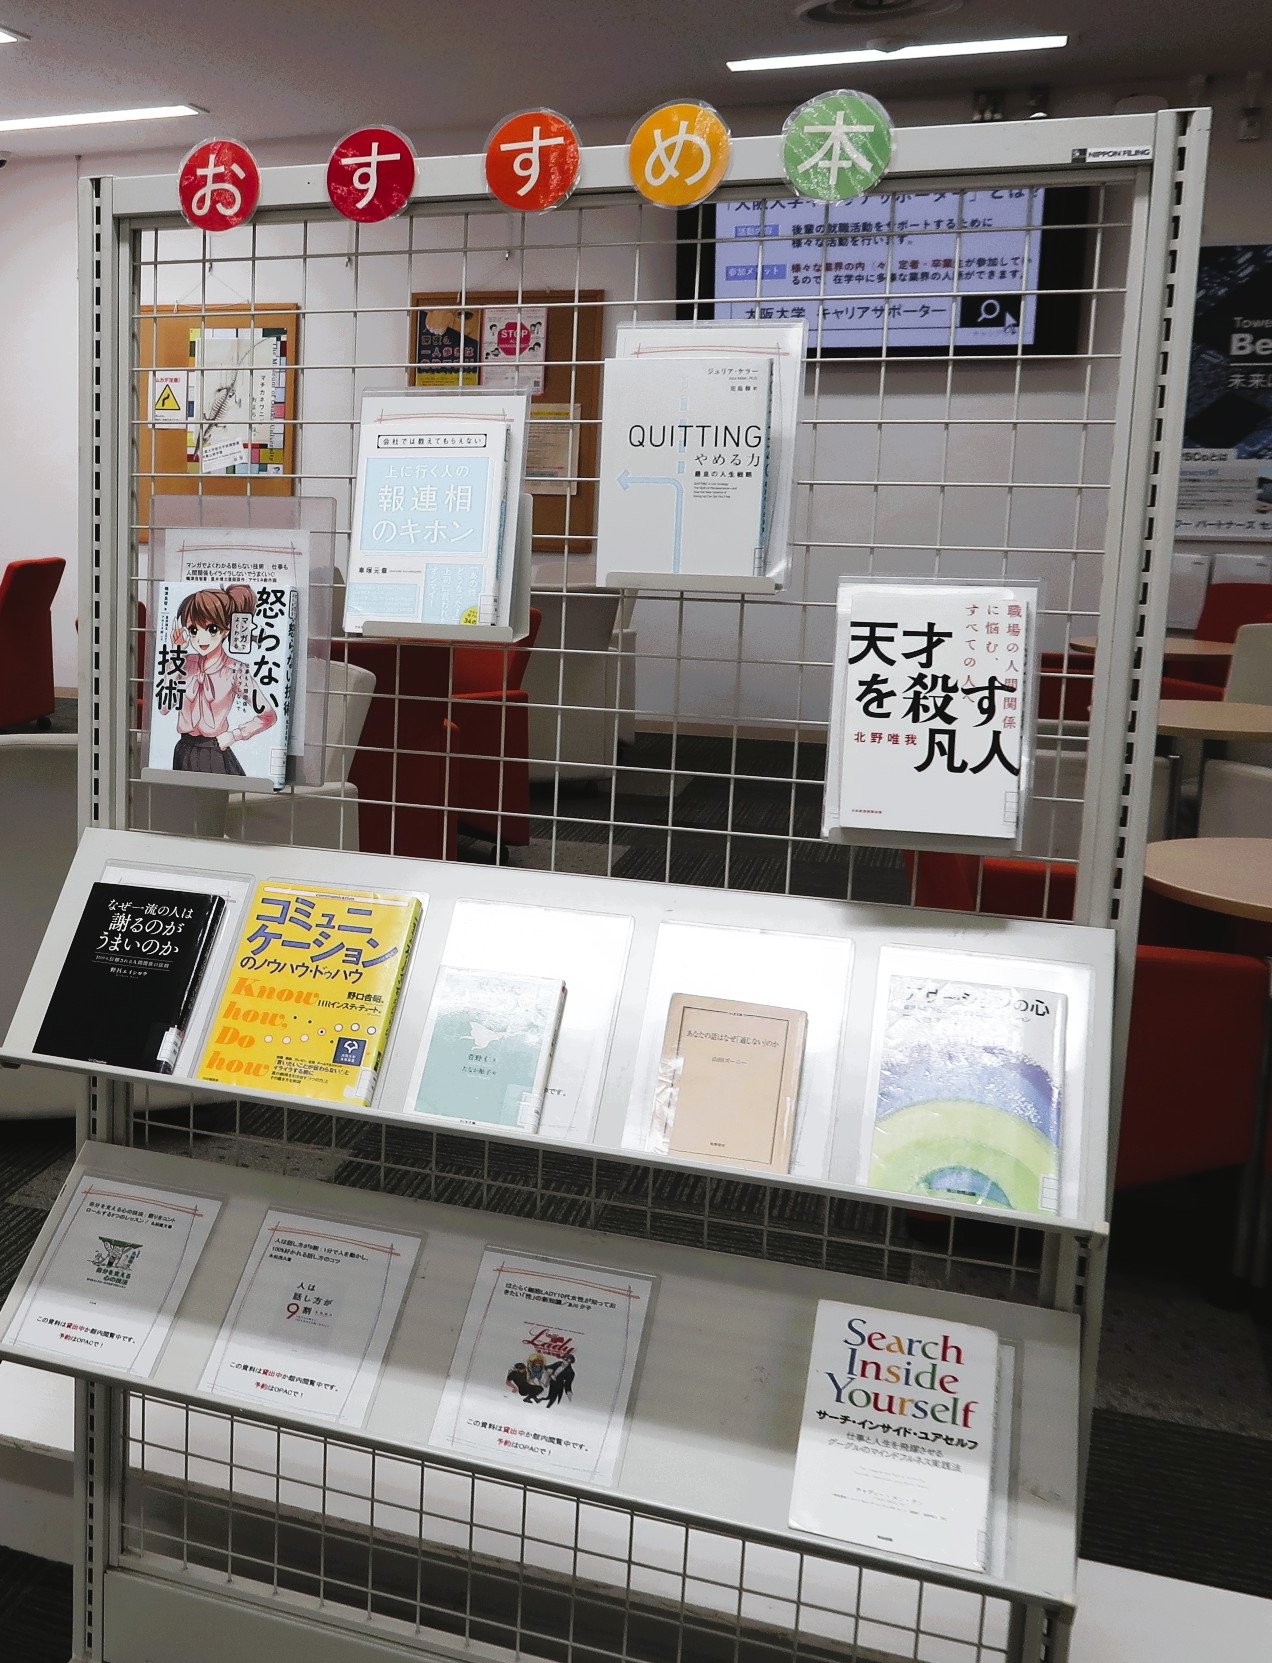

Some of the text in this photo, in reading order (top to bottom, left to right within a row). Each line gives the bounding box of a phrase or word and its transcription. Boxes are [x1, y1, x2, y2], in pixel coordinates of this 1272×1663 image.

[383, 437, 482, 446] 会社では教えてもらえない
[629, 425, 762, 448] QUITTING
[385, 464, 470, 479] 上に行く人の
[694, 453, 760, 467] やめる力
[378, 484, 472, 513] 報連相
[372, 519, 474, 545] のキホン
[252, 586, 286, 714] 怒らない
[848, 621, 953, 669] 天才
[155, 644, 188, 711] 技術
[1003, 604, 1023, 729] 職場の人間関係
[855, 672, 1017, 727] を殺す
[854, 731, 918, 746] 北野唯我
[913, 728, 1020, 776] 凡人
[108, 898, 194, 919] なぜ一流の人は
[256, 897, 373, 934] コミュニ
[108, 912, 185, 936] 謝るのが
[96, 931, 179, 956] うまいのか
[247, 923, 399, 969] ケーション
[240, 956, 364, 984] のノウハウ・ドゥハウ
[231, 977, 320, 1006] Know
[222, 1001, 288, 1029] how,
[215, 1026, 255, 1049] Do
[206, 1050, 271, 1078] how
[292, 1292, 333, 1306] 話し方が
[297, 1282, 316, 1291] 人は
[843, 1318, 965, 1365] Search
[847, 1348, 959, 1395] Inside
[825, 1371, 980, 1428] Yourself
[816, 1409, 979, 1450] サーチ・インサイド・ユアセルフ
